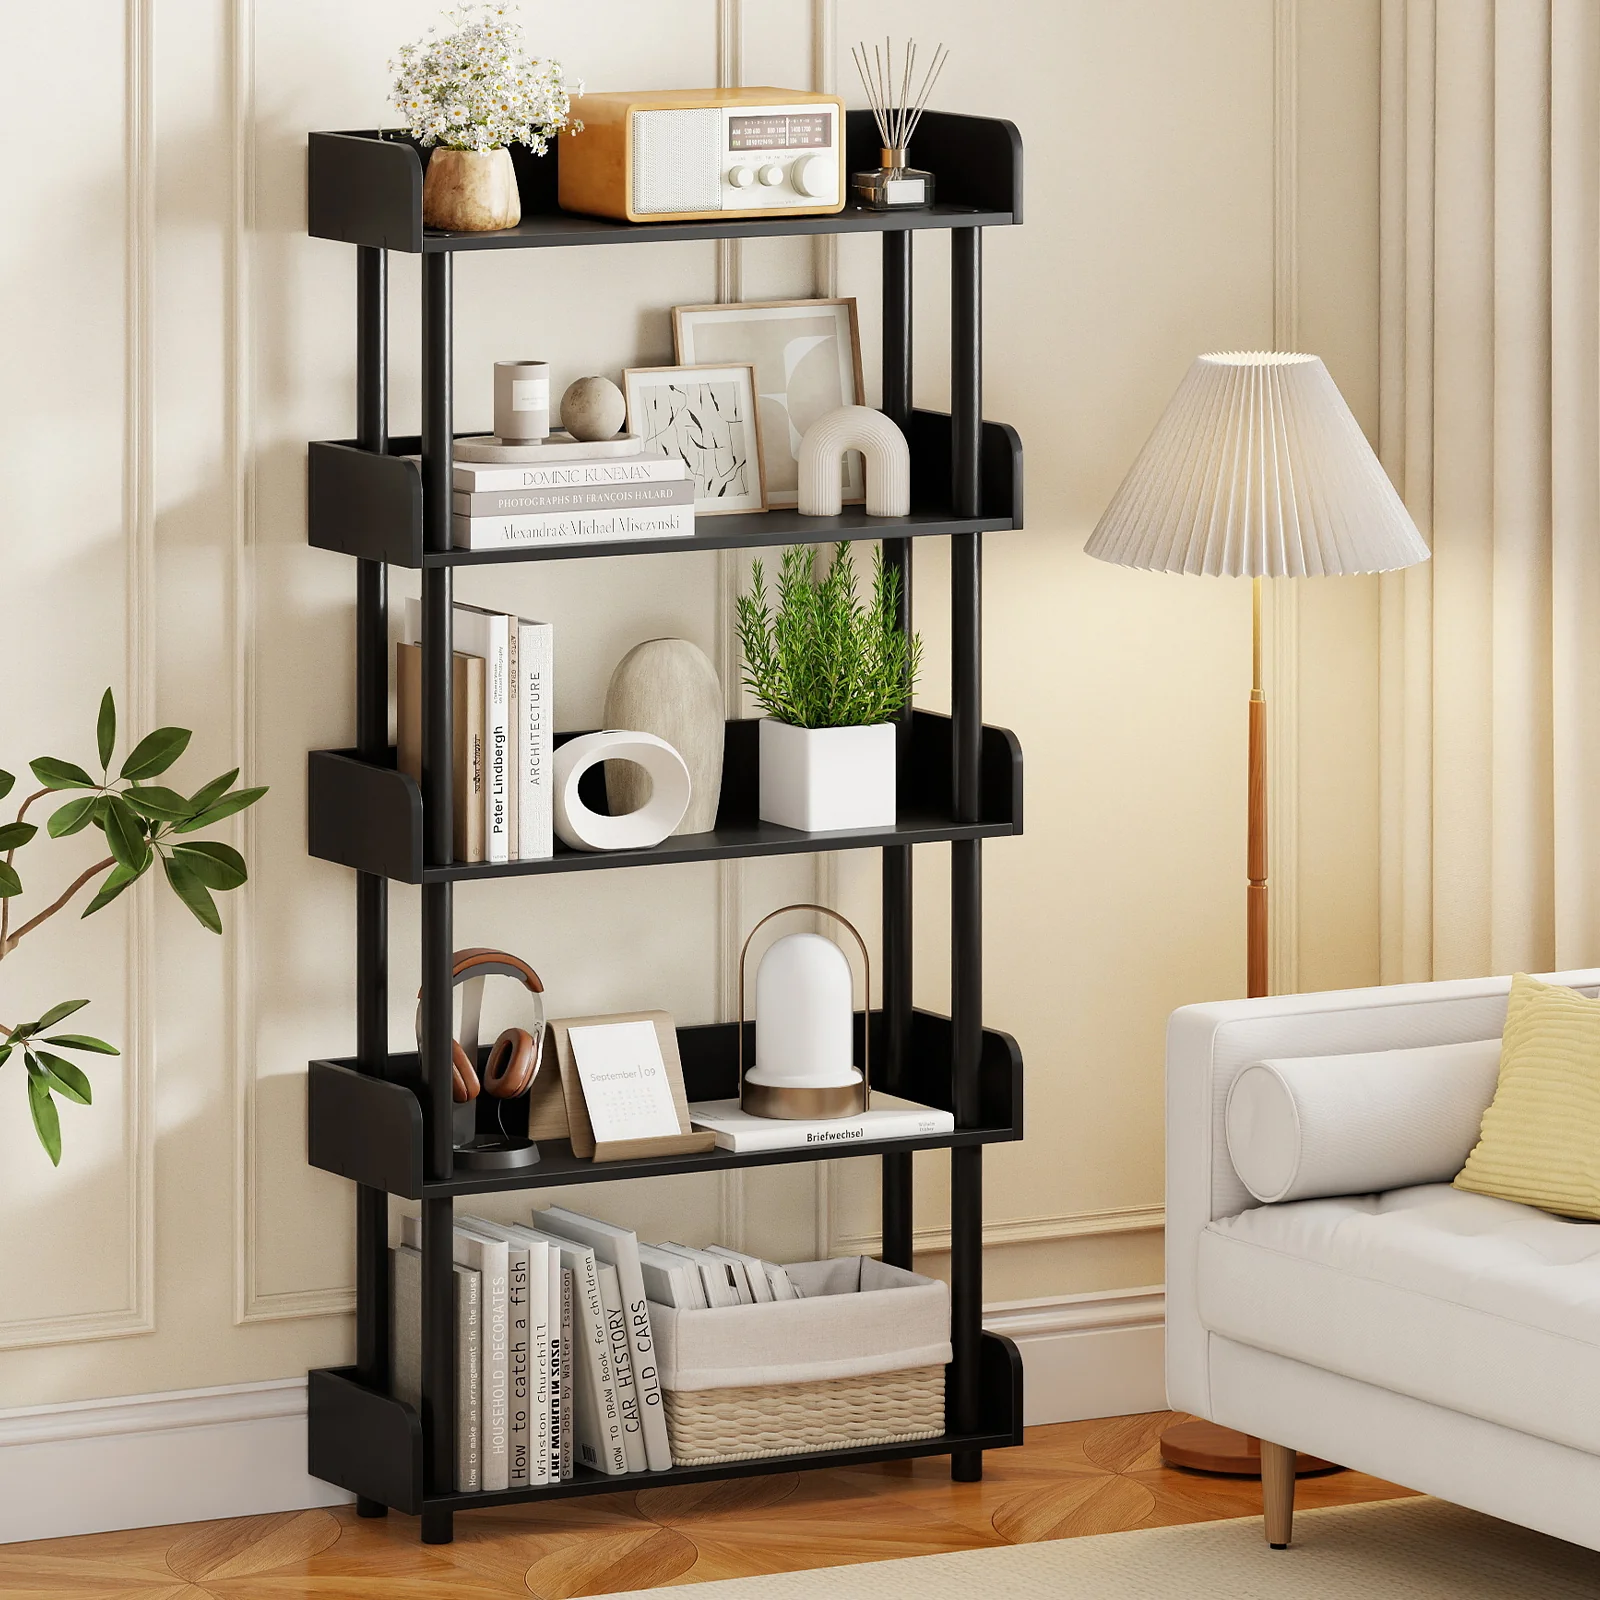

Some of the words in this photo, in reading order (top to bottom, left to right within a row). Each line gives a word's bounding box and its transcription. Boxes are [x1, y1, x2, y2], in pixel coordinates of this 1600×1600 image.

[523, 469, 579, 486] DOMINIC
[585, 465, 651, 482] KUNEMAN
[498, 494, 570, 508] PHOTOGRAPHS
[572, 493, 584, 504] BY
[586, 491, 633, 503] FRANÇOIS
[635, 488, 673, 499] HALARD
[619, 514, 679, 533] Misczynski
[530, 672, 540, 785] ARCHITECTURE
[493, 726, 505, 795] Lindbergh
[493, 798, 503, 834] Peter
[590, 1070, 637, 1082] September
[644, 1067, 656, 1077] 09
[806, 1127, 864, 1142] Briefwechsel
[468, 1277, 476, 1306] house
[510, 1261, 526, 1306] fish
[585, 1256, 600, 1315] children
[562, 1272, 570, 1328] Isaacson
[468, 1312, 476, 1326] the
[492, 1276, 504, 1361] DECORATES
[515, 1318, 526, 1329] a
[630, 1299, 652, 1352] CARS
[468, 1330, 476, 1341] in
[594, 1324, 604, 1345] for
[606, 1308, 633, 1388] HISTORY
[510, 1341, 526, 1398] catch
[536, 1322, 546, 1403] Churchill
[561, 1337, 571, 1379] Walter
[598, 1351, 611, 1382] Book
[469, 1346, 477, 1405] arrangement
[641, 1366, 660, 1406] OLD
[561, 1385, 571, 1400] by
[603, 1388, 616, 1419] DRAW
[470, 1409, 476, 1421] an
[492, 1370, 504, 1454] HOUSEHOLD
[511, 1410, 526, 1433] to
[561, 1406, 571, 1434] Jobs
[622, 1397, 640, 1433] CAR
[468, 1426, 476, 1449] make
[536, 1412, 546, 1477] Winston
[609, 1425, 619, 1441] TO
[469, 1453, 476, 1463] to
[511, 1445, 526, 1479] How
[562, 1441, 570, 1477] Steve
[613, 1447, 624, 1470] HOW
